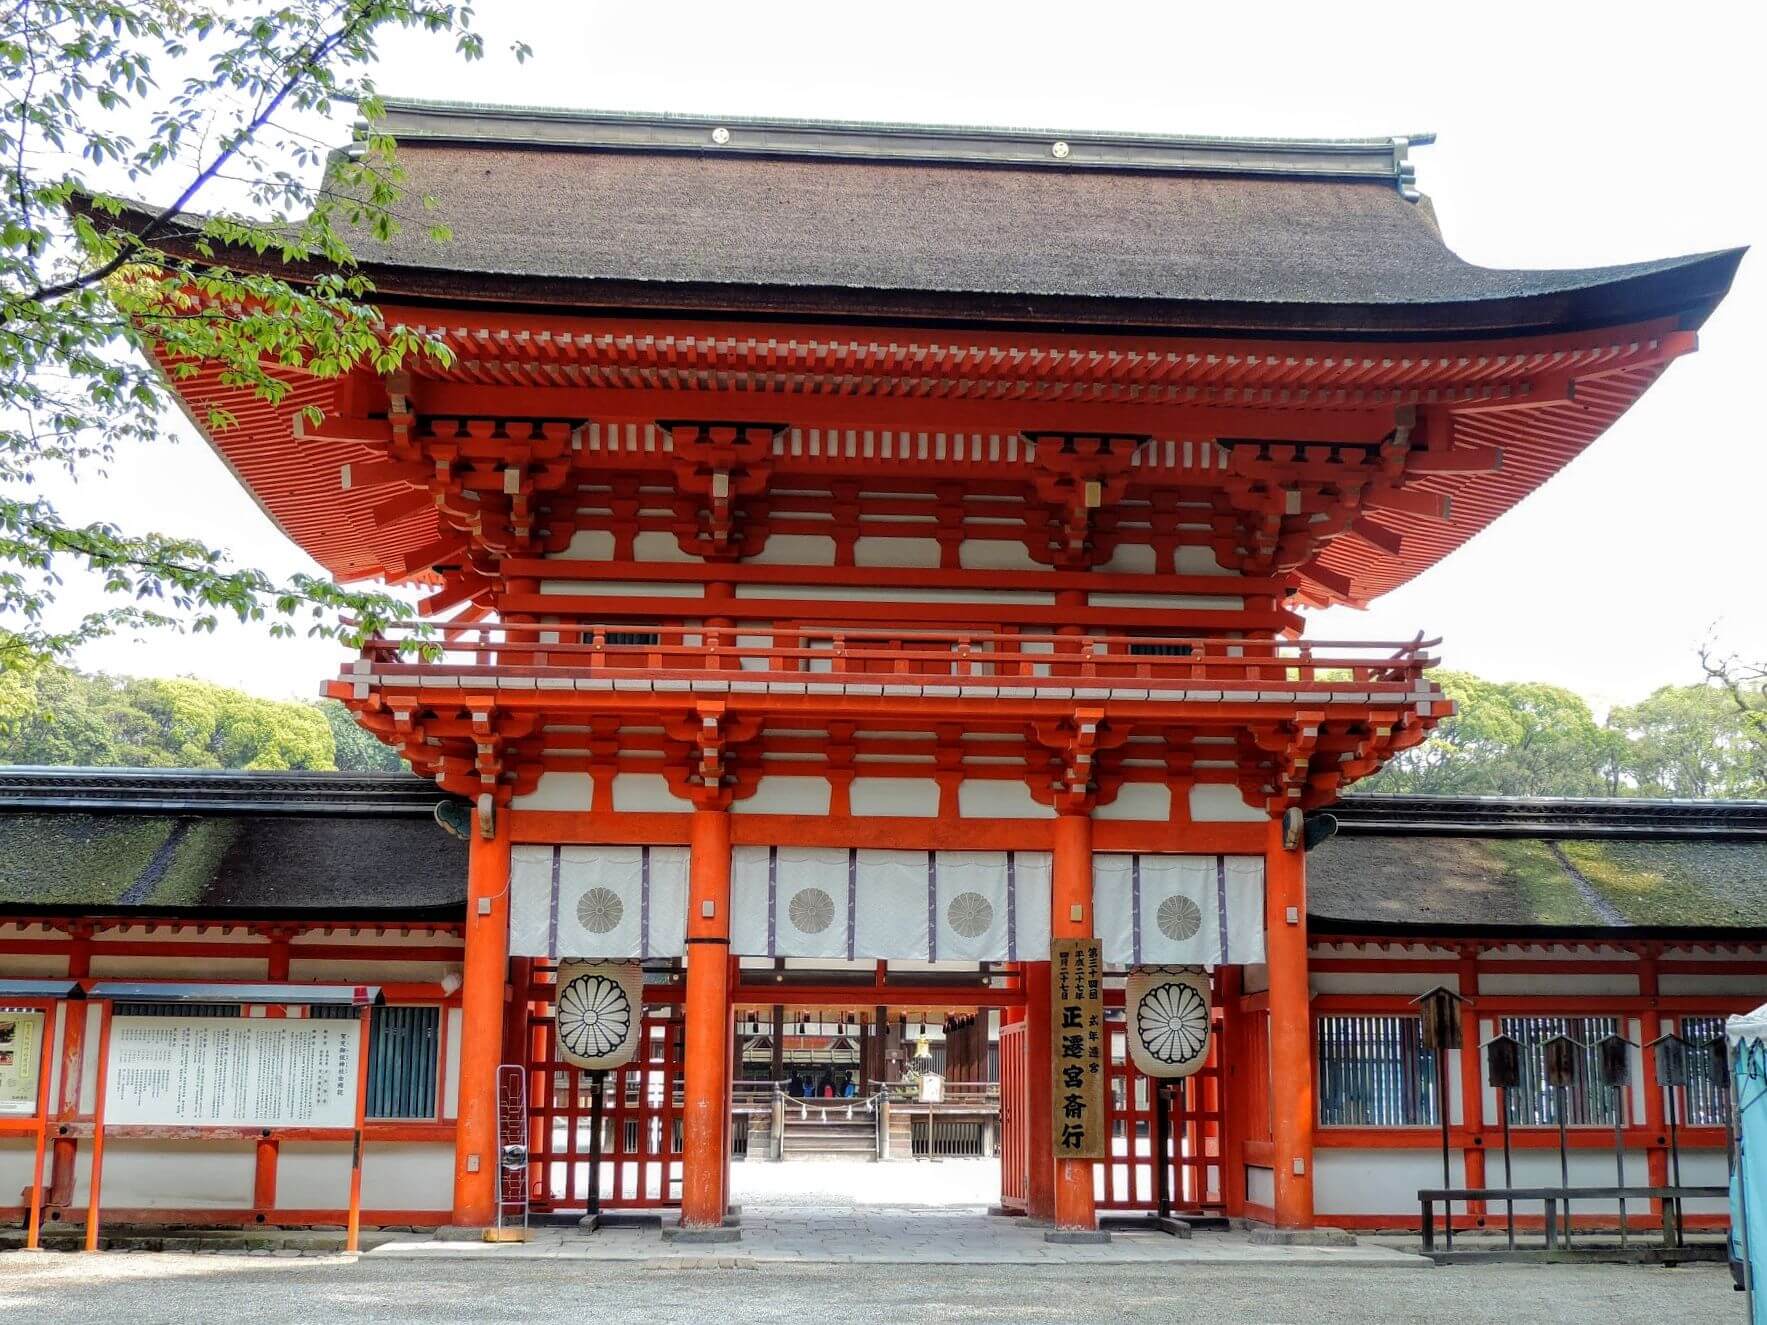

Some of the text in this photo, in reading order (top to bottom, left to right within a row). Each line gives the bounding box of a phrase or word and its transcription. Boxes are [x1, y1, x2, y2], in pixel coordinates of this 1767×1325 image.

[1059, 951, 1069, 1000] 四月二十七日
[1075, 950, 1085, 1000] 平成二十七年
[1088, 947, 1099, 1074] 第三十四回 式年遷宮
[1061, 1006, 1087, 1149] 正遷宮斎行
